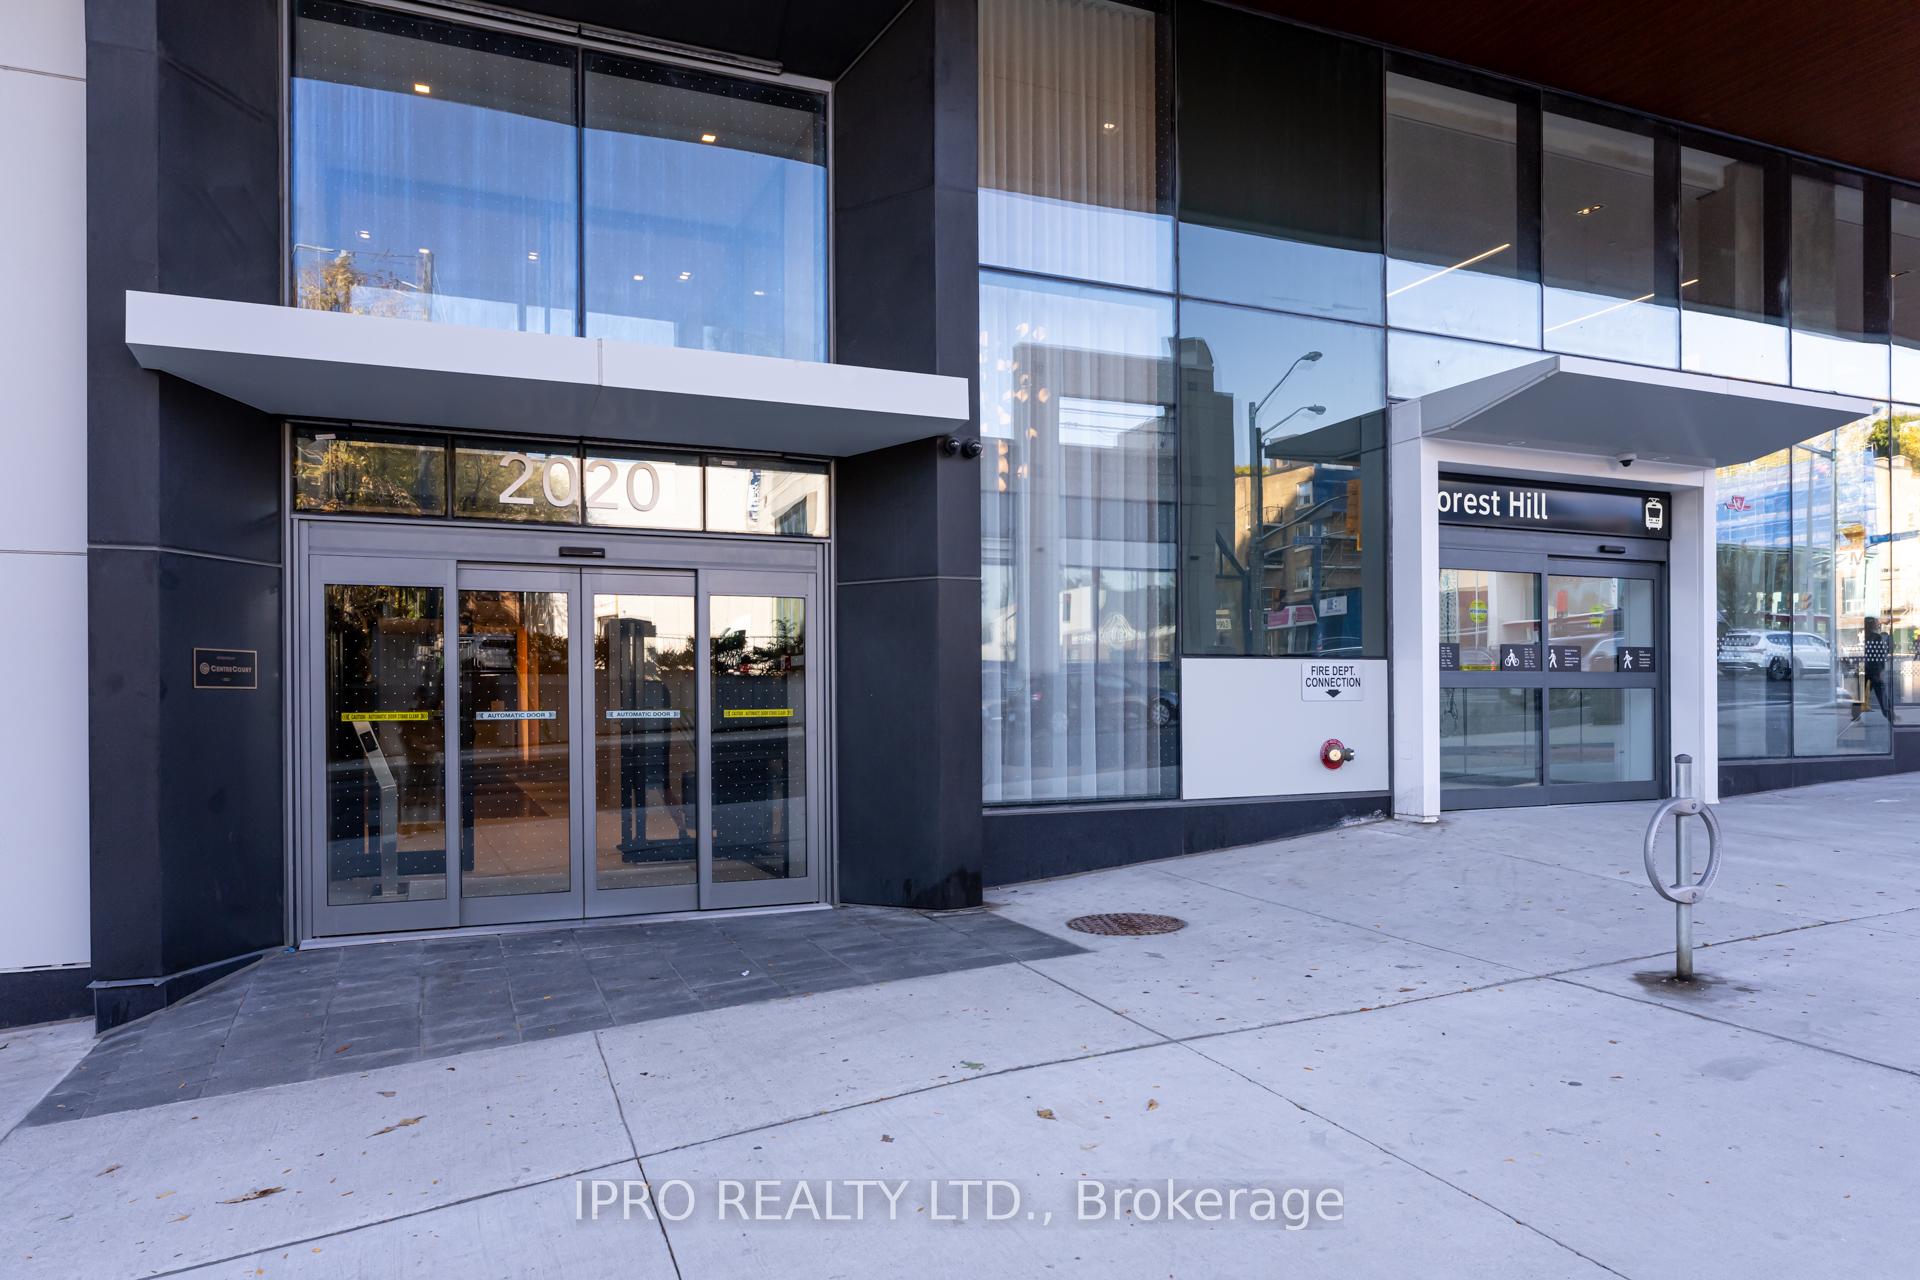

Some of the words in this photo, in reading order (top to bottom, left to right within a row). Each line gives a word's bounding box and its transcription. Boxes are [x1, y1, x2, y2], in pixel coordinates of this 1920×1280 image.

[499, 454, 660, 512] 2020
[1437, 490, 1501, 517] orest
[1509, 491, 1548, 520] Hill
[1311, 665, 1330, 676] FIRE
[1332, 665, 1356, 676] DEPT.
[1305, 677, 1361, 688] CONNECTION
